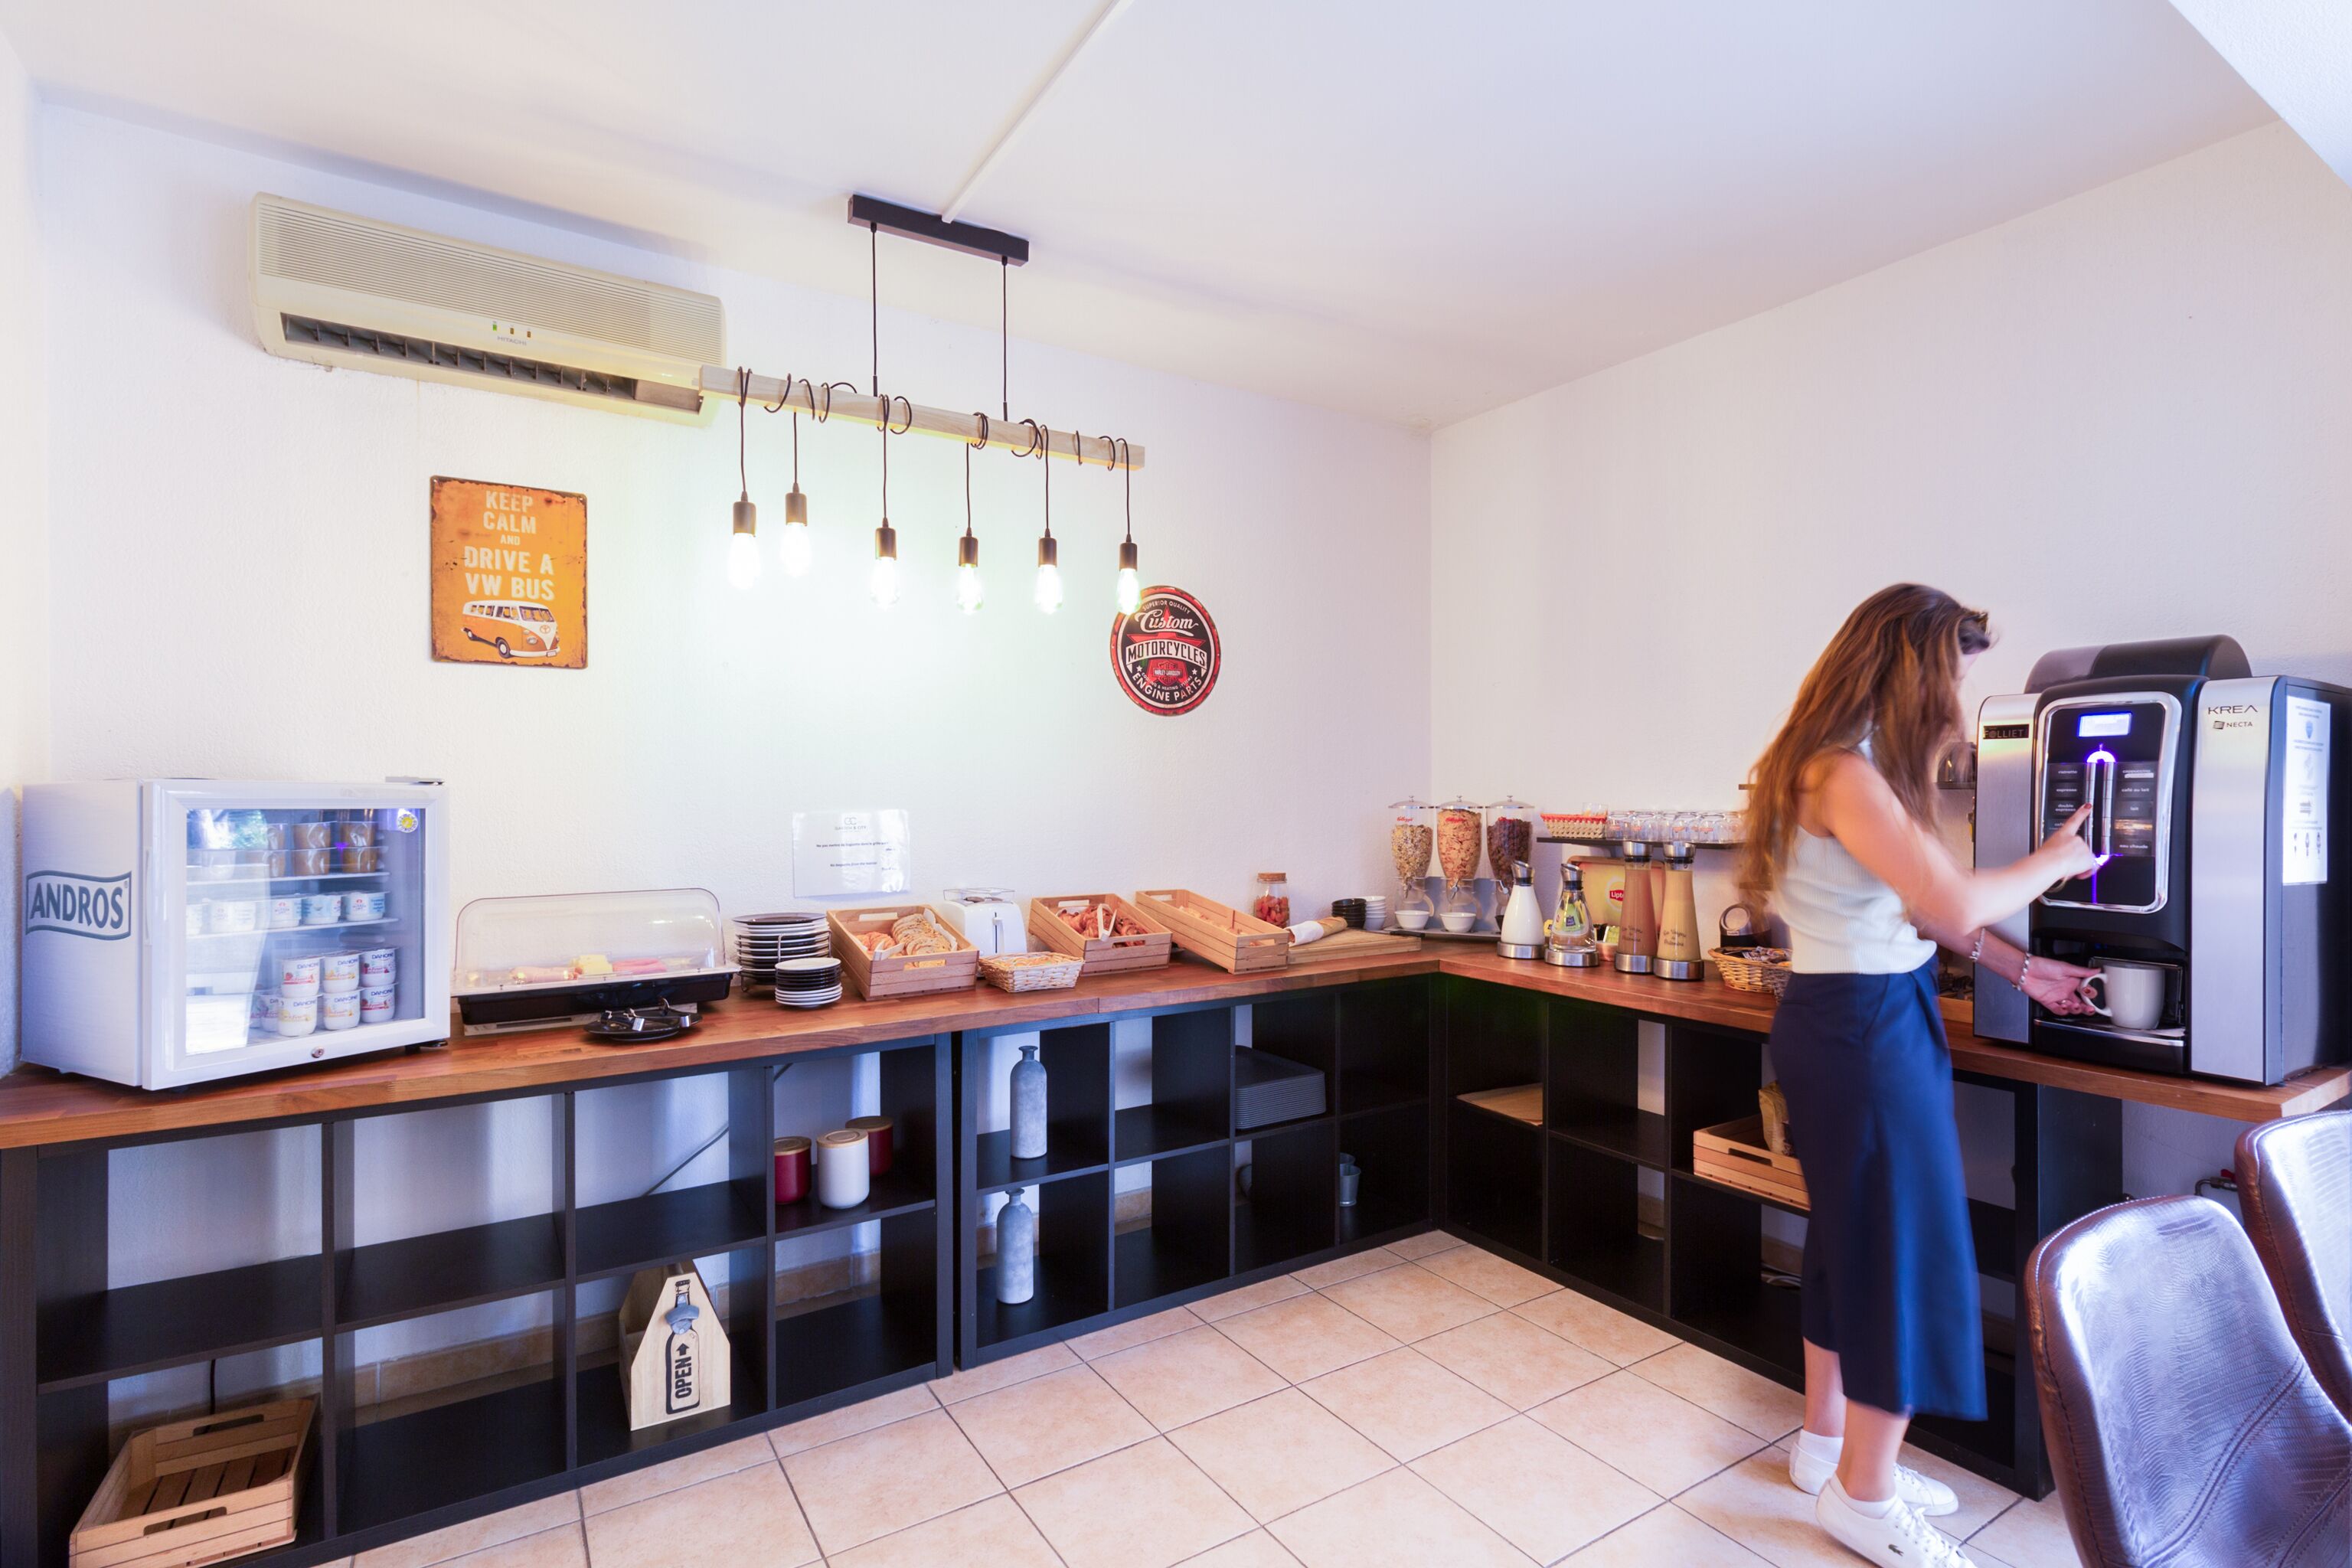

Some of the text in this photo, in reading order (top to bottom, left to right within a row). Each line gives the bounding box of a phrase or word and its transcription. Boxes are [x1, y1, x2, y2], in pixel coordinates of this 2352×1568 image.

[497, 336, 527, 345] HITACHI
[485, 490, 533, 513] KEEP
[483, 511, 536, 534] CALM
[500, 534, 521, 546] AND
[464, 546, 554, 574] DRIVE A
[465, 573, 554, 601] VW BUS
[1142, 600, 1191, 615] SUPERIOR QUALITY
[1135, 609, 1199, 637] Custom
[1128, 640, 1207, 668] MOTORCYCLES
[1132, 672, 1202, 701] ENGINE PARTS
[2207, 704, 2259, 714] KREA
[1984, 729, 2024, 738] FOLLIET
[29, 882, 123, 929] ANDROS
[675, 1357, 691, 1400] OPEN
